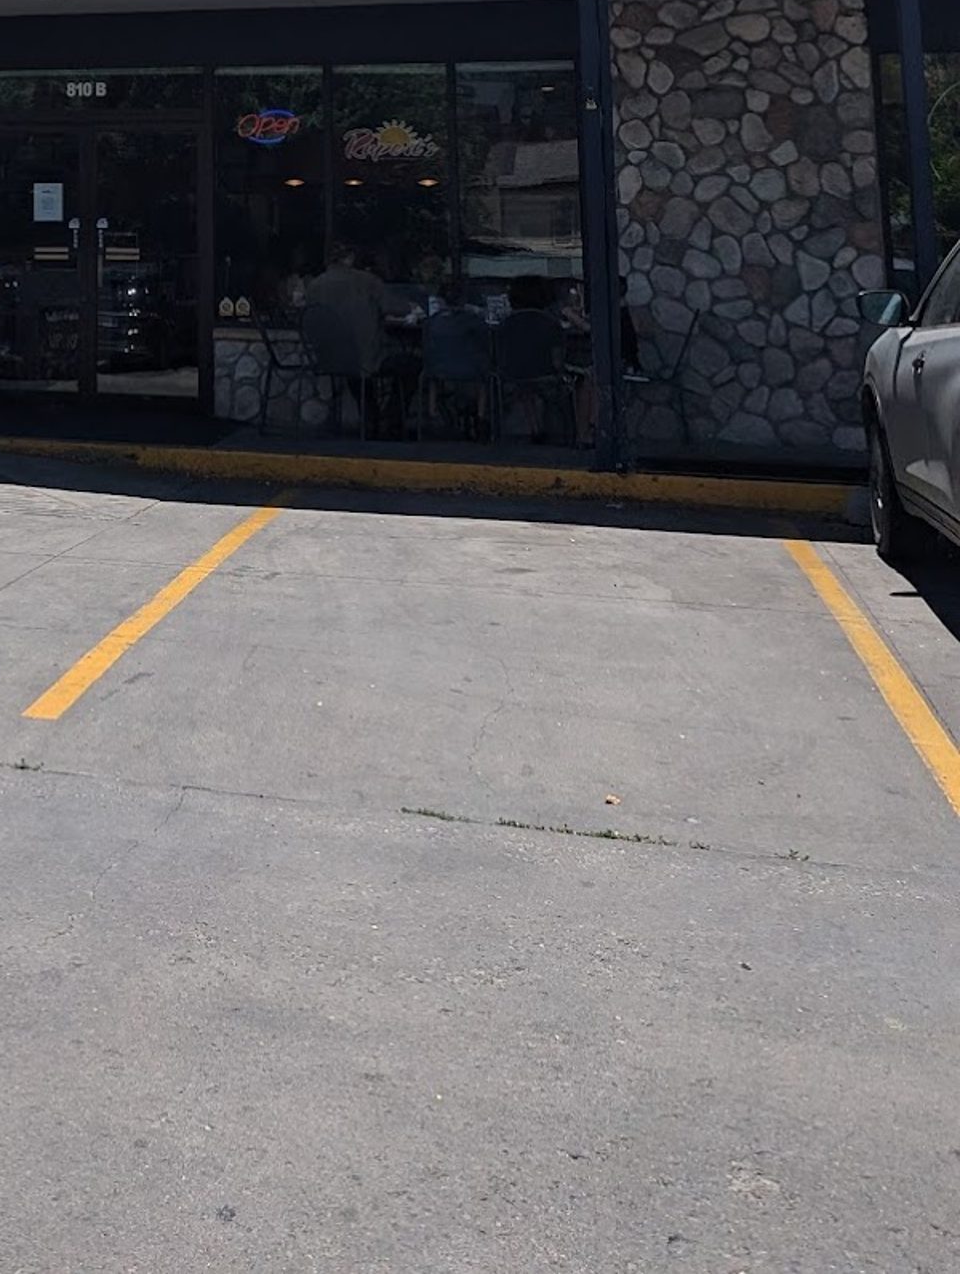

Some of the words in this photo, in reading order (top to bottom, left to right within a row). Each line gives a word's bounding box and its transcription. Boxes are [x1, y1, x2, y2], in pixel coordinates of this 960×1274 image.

[66, 82, 93, 97] 810
[95, 82, 107, 97] B
[237, 113, 301, 138] Open
